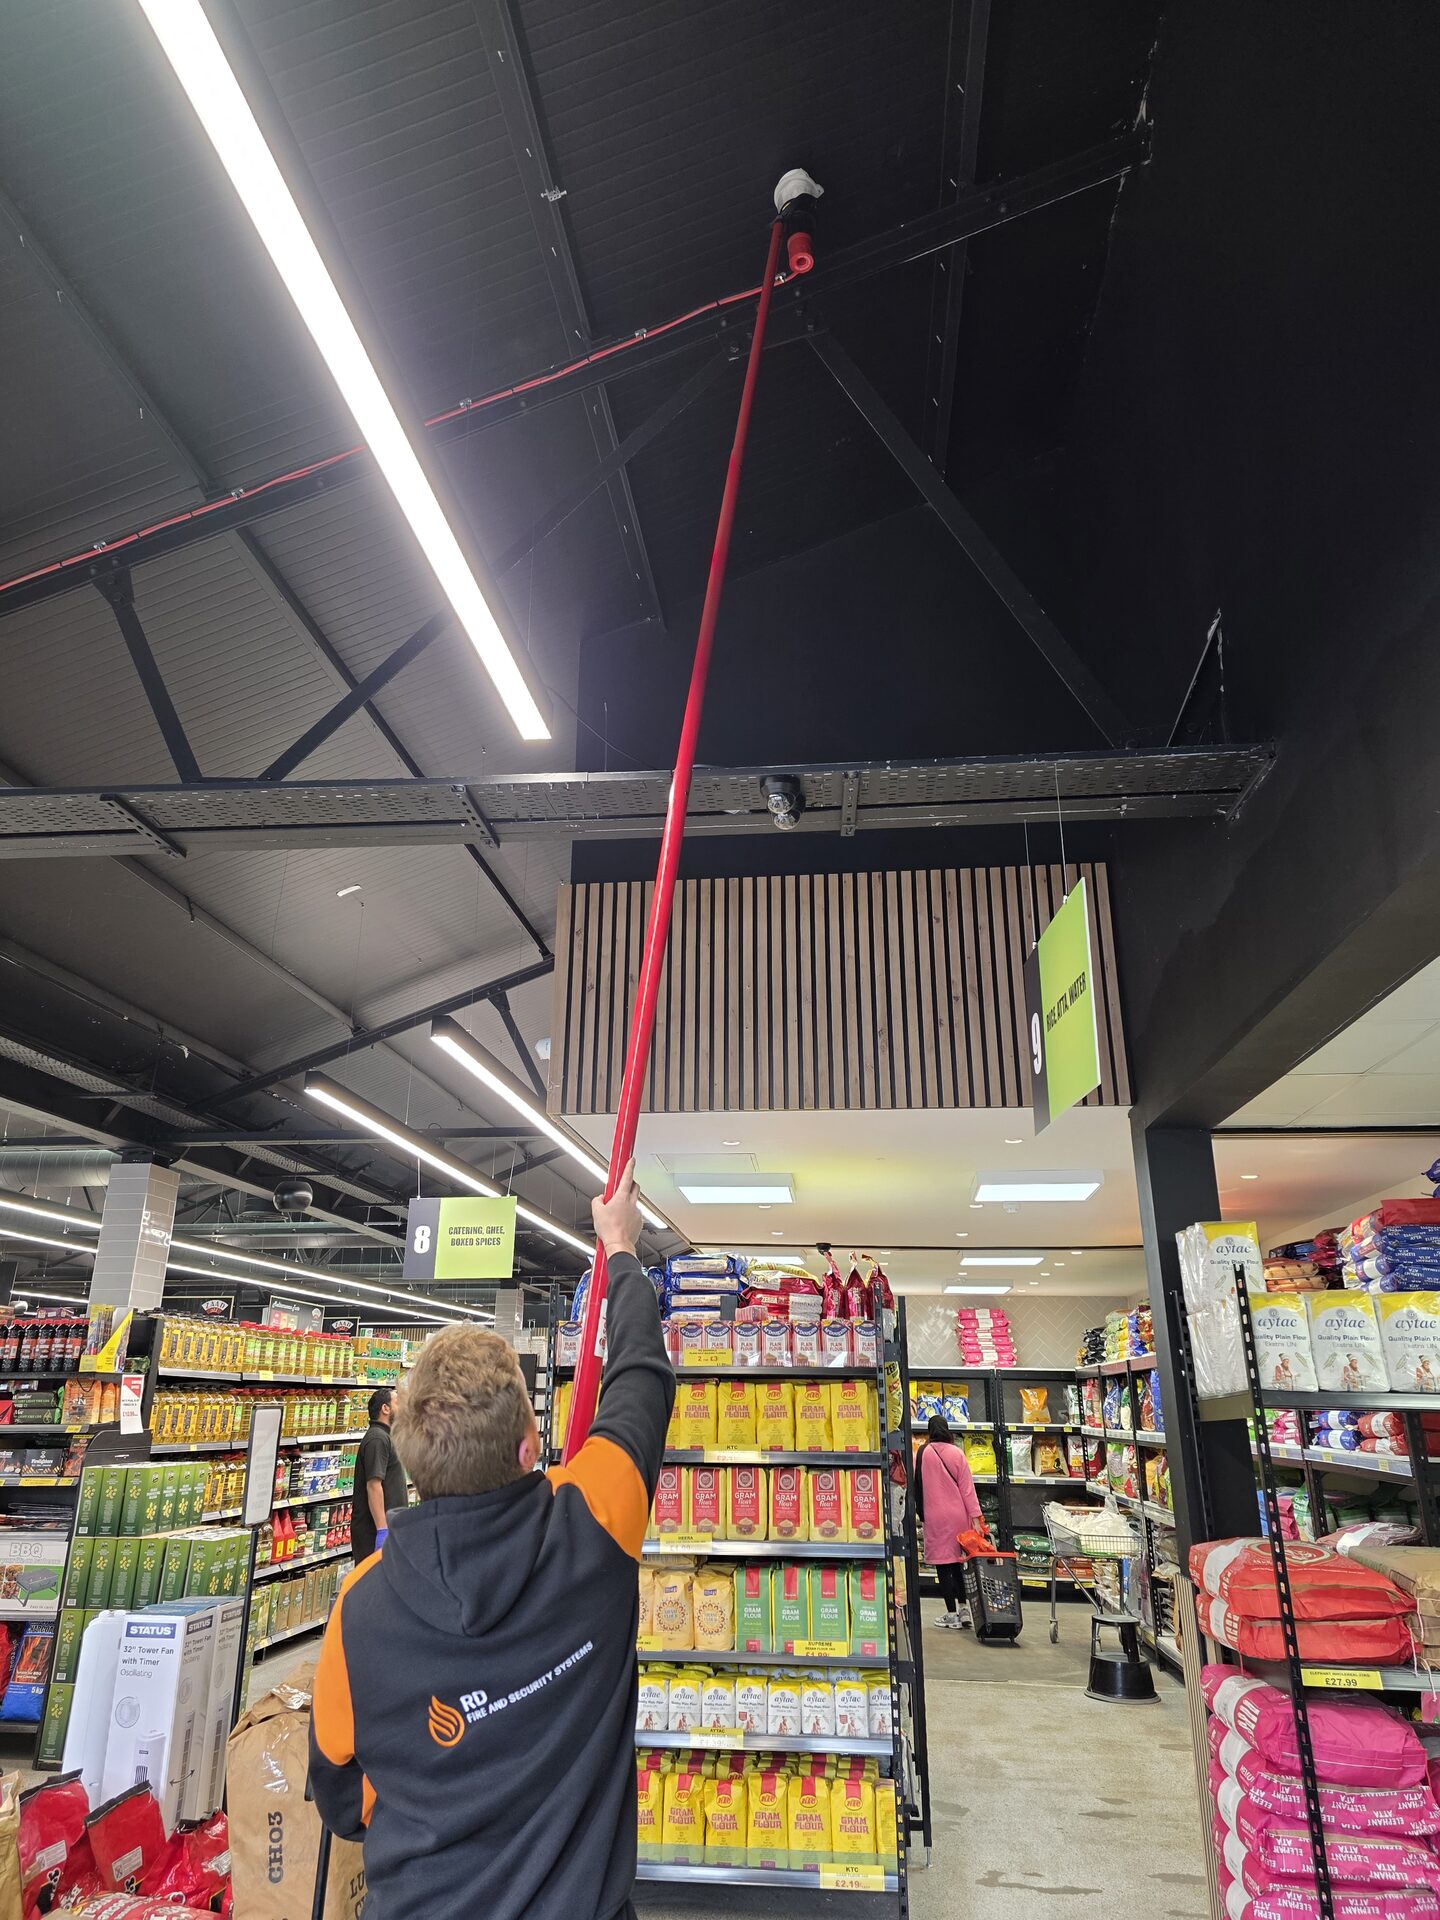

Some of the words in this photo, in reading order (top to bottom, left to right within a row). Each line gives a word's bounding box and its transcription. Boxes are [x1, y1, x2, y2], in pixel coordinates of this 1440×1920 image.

[1068, 971, 1087, 1006] WATER
[1031, 1012, 1042, 1075] 9
[448, 1226, 485, 1235] CATERING,
[485, 1226, 505, 1235] GHEE,
[414, 1225, 431, 1254] 8
[450, 1237, 474, 1246] BOXED
[475, 1237, 501, 1246] SPICES
[1216, 1245, 1251, 1256] aytac
[1257, 1318, 1297, 1330] aytac
[1325, 1317, 1366, 1330] aytac
[1395, 1318, 1437, 1331] aytac
[1317, 1334, 1341, 1342] Quality
[1388, 1335, 1413, 1343] Quality
[684, 1411, 710, 1419] FLOUR
[725, 1411, 751, 1419] FLOUR
[762, 1411, 788, 1419] FLOUR
[9, 1543, 43, 1558] BBQ
[188, 1618, 211, 1632] STATUS
[129, 1625, 172, 1635] STATUS
[192, 1638, 203, 1646] Tower
[138, 1646, 159, 1654] Tower
[192, 1645, 204, 1653] Timer
[139, 1658, 160, 1666] Timer
[120, 1668, 153, 1678] Oscillating
[466, 1706, 488, 1723] FIRE
[488, 1698, 508, 1715] AND
[508, 1671, 554, 1704] SECURITY
[553, 1640, 594, 1677] SYSTEMS
[1325, 1677, 1358, 1687] £27.99
[641, 1691, 660, 1699] aytac
[674, 1692, 694, 1701] aytac
[707, 1693, 727, 1701] aytac
[741, 1692, 761, 1700] aytac
[459, 1689, 488, 1713] RD
[774, 1696, 794, 1704] aytac
[807, 1696, 827, 1704] aytac
[1403, 1793, 1423, 1801] ATTA
[670, 1807, 694, 1816] GRAM
[1373, 1810, 1393, 1819] ATTA
[668, 1815, 696, 1825] FLOUR
[711, 1813, 736, 1822] GRAM
[755, 1812, 780, 1821] GRAM
[796, 1813, 822, 1822] GRAM
[841, 1816, 867, 1825] GRAM
[753, 1820, 782, 1829] FLOUR
[794, 1822, 824, 1831] FLOUR
[1367, 1817, 1404, 1827] ELEPHANT
[839, 1825, 869, 1834] FLOUR
[1337, 1845, 1358, 1854] ATTA
[1331, 1853, 1369, 1863] ELEPHANT
[1376, 1863, 1396, 1872] ATTA
[1369, 1871, 1408, 1881] ELEPHANT
[1348, 1898, 1369, 1906] ATTA
[1340, 1905, 1380, 1915] ELEPHANT
